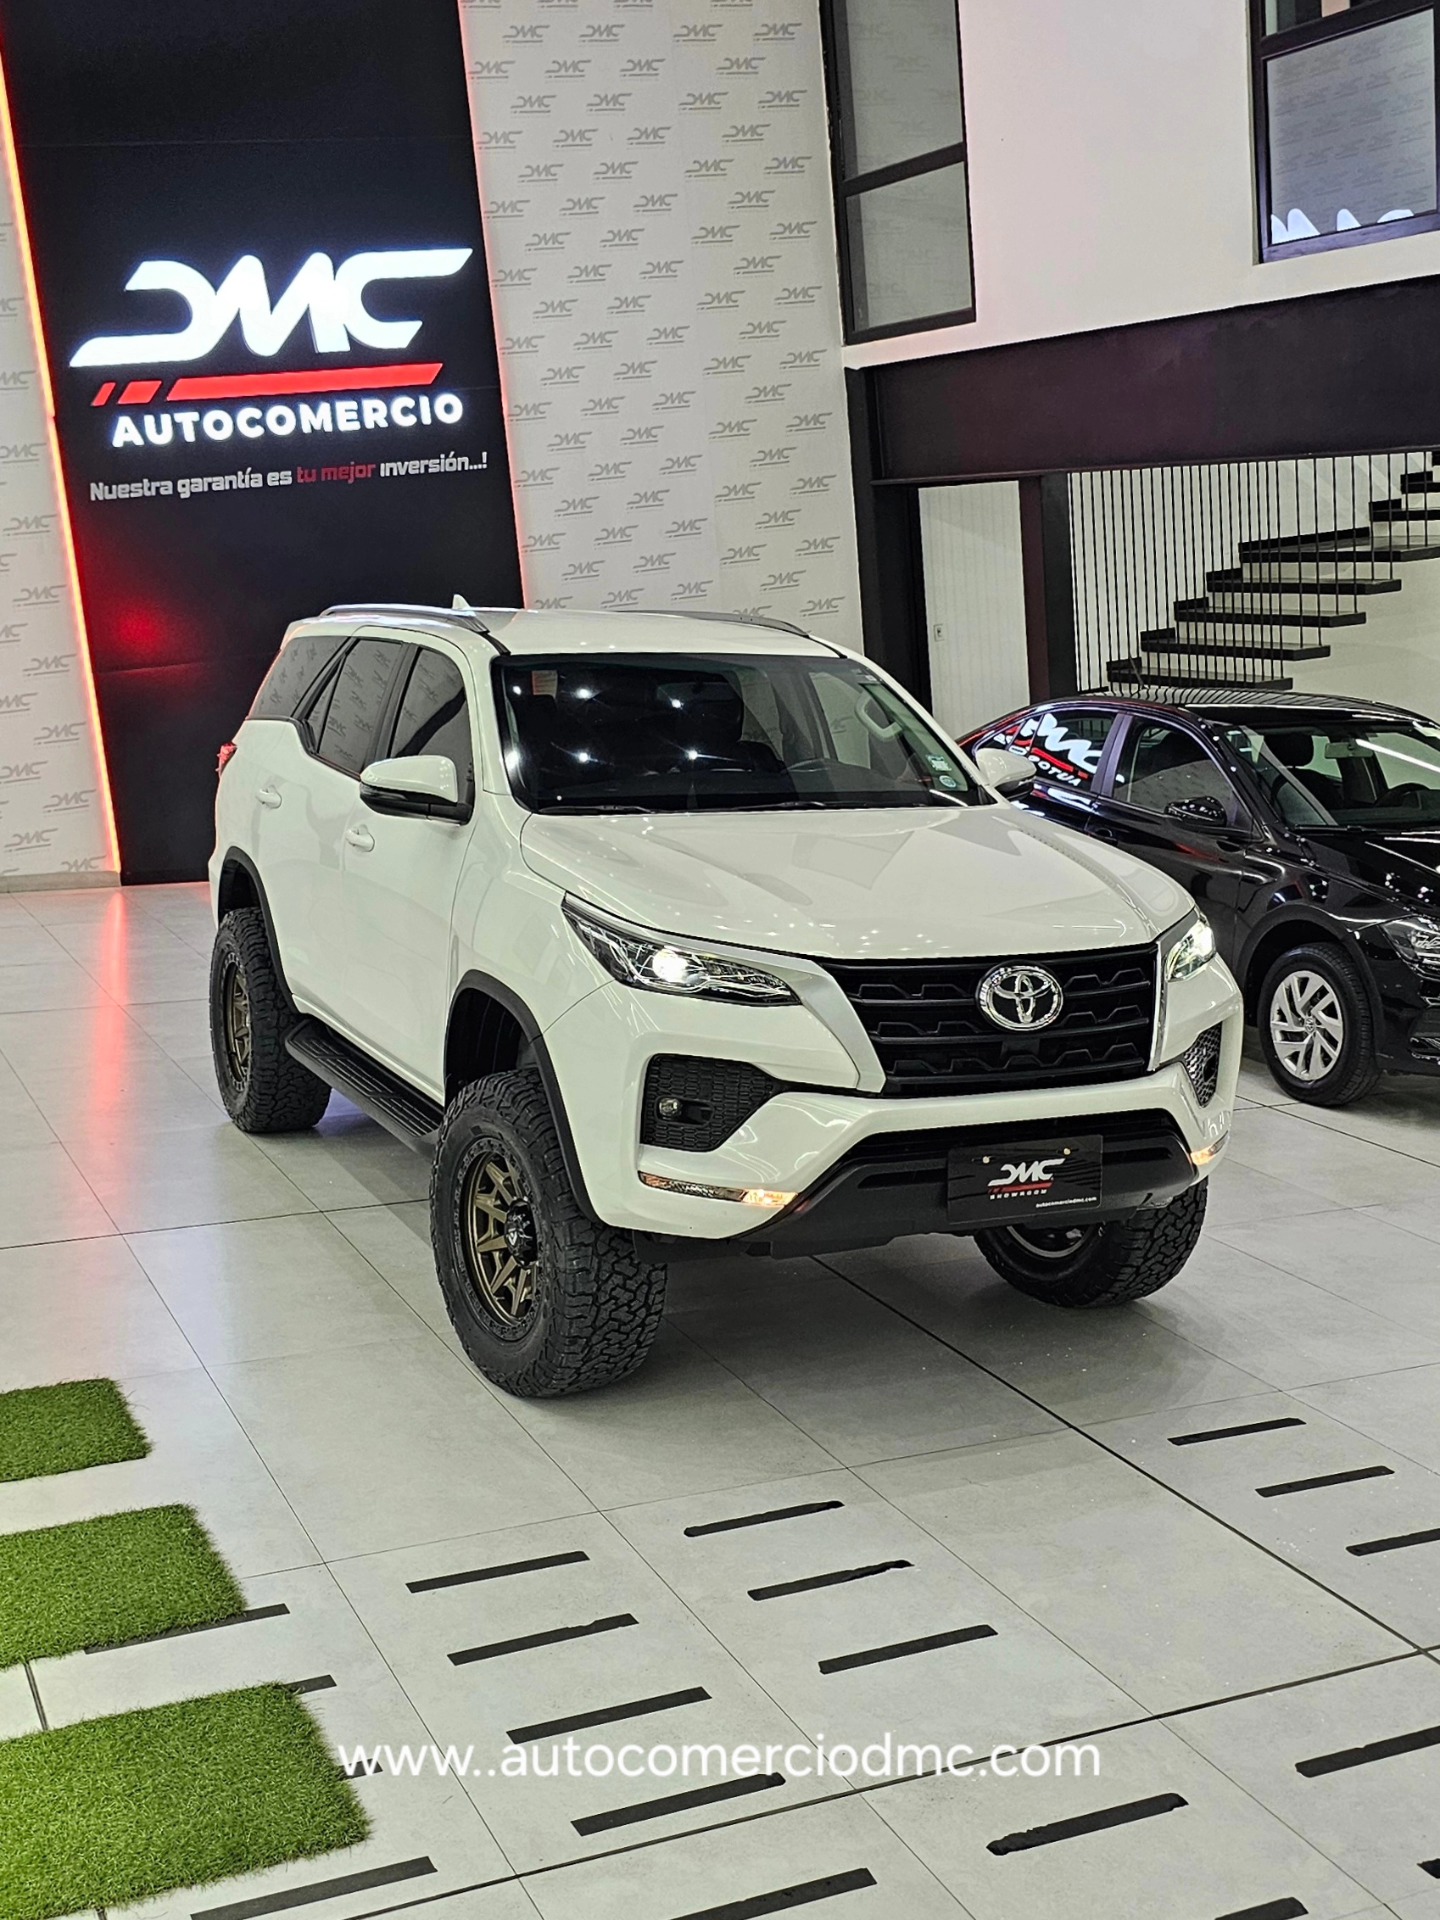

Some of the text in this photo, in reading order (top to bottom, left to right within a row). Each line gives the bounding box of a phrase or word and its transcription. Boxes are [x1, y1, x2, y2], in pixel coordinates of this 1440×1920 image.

[502, 24, 550, 39] DMC
[579, 23, 625, 38] DMC
[672, 23, 724, 38] DMC
[753, 22, 803, 37] DMC
[470, 60, 516, 75] DMC
[544, 59, 592, 74] DMC
[620, 58, 666, 73] DMC
[716, 56, 766, 71] DMC
[510, 94, 557, 109] DMC
[586, 92, 633, 107] DMC
[678, 91, 729, 106] DMC
[757, 89, 808, 105] DMC
[479, 130, 523, 145] DMC
[552, 128, 599, 143] DMC
[626, 126, 672, 141] DMC
[721, 123, 771, 138] DMC
[518, 163, 564, 178] DMC
[593, 160, 639, 176] DMC
[684, 158, 735, 174] DMC
[763, 155, 813, 171] DMC
[559, 196, 606, 212] DMC
[632, 193, 679, 208] DMC
[727, 189, 776, 205] DMC
[484, 199, 531, 214] DMC
[599, 227, 646, 243] DMC
[691, 224, 741, 240] DMC
[769, 220, 818, 236] DMC
[524, 231, 572, 247] DMC
[567, 263, 613, 279] DMC
[639, 259, 685, 275] DMC
[733, 255, 782, 271] DMC
[491, 267, 538, 283] DMC
[696, 289, 746, 306] DMC
[774, 285, 823, 301] DMC
[69, 248, 473, 367] DMC
[533, 298, 579, 315] DMC
[606, 294, 652, 310] DMC
[646, 325, 691, 341] DMC
[738, 320, 787, 336] DMC
[501, 335, 545, 350] DMC
[573, 330, 619, 346] DMC
[703, 354, 752, 372] DMC
[779, 348, 828, 366] DMC
[540, 365, 586, 382] DMC
[613, 360, 658, 376] DMC
[651, 390, 697, 407] DMC
[744, 383, 793, 400] DMC
[507, 401, 552, 417] DMC
[580, 395, 626, 412] DMC
[111, 393, 464, 448] AUTOCOMERCIO
[708, 418, 758, 435] DMC
[785, 411, 833, 429] DMC
[547, 431, 593, 448] DMC
[620, 425, 665, 442] DMC
[659, 454, 703, 471] DMC
[749, 446, 798, 463] DMC
[514, 467, 560, 484] DMC
[587, 461, 633, 477] DMC
[90, 478, 174, 501] Nuestra
[177, 467, 263, 499] garantía
[267, 470, 292, 487] es
[297, 466, 317, 483] tu
[321, 461, 376, 484] mejor
[789, 474, 837, 491] DMC
[626, 488, 671, 506] DMC
[714, 481, 762, 499] DMC
[554, 495, 600, 513] DMC
[2, 514, 58, 532] DMC
[754, 508, 802, 526] DMC
[593, 524, 639, 542] DMC
[664, 517, 708, 535] DMC
[522, 532, 567, 549] DMC
[794, 535, 841, 553] DMC
[632, 552, 677, 569] DMC
[719, 543, 768, 562] DMC
[561, 559, 606, 577] DMC
[760, 569, 807, 588] DMC
[12, 585, 67, 602] DMC
[600, 587, 645, 605] DMC
[670, 579, 714, 597] DMC
[799, 596, 846, 613] DMC
[22, 653, 77, 672] DMC
[34, 721, 87, 741] DMC
[43, 788, 97, 809] DMC
[4, 828, 58, 848] DMC
[987, 1158, 1066, 1187] DMC
